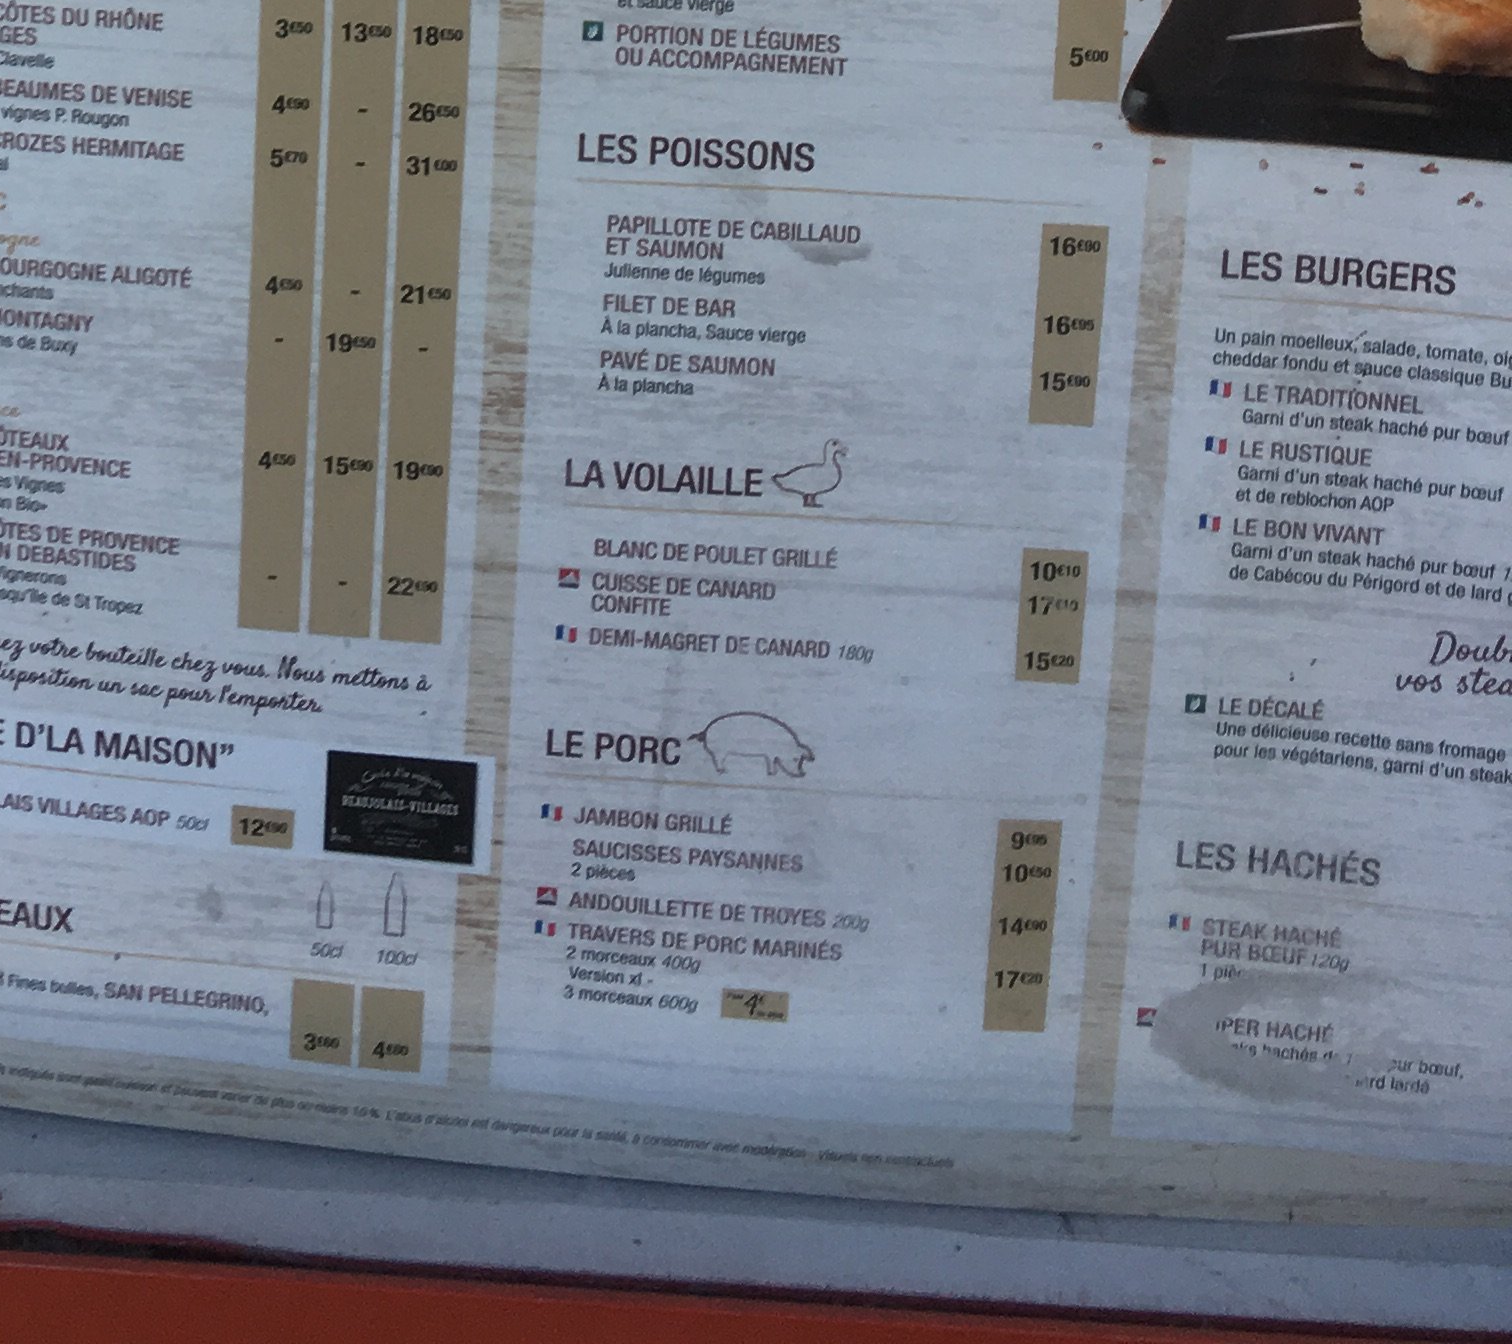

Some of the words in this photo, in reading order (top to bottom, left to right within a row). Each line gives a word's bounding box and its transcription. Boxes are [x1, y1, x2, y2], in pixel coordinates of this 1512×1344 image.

[617, 25, 704, 46] PORTION
[710, 28, 736, 48] DE
[744, 29, 841, 52] LÉGUMES
[615, 46, 644, 67] OU
[649, 49, 848, 76] ACCOMPAGNEMENT
[577, 133, 638, 165] LES
[650, 137, 815, 172] POISSONS
[1221, 250, 1283, 282] LES
[1294, 255, 1457, 295] BURGERS
[1240, 441, 1264, 460] LE
[1270, 443, 1373, 467] RUSTIQUE
[565, 459, 603, 488] LA
[613, 461, 764, 496] VOLAILLE
[594, 540, 658, 561] BLANC
[663, 543, 689, 562] DE
[694, 544, 767, 566] POULET
[772, 547, 838, 569] GRILLÉ
[28, 639, 81, 660] votre
[85, 634, 167, 668] bouteille
[172, 653, 218, 679] chez
[222, 661, 269, 677] vous.
[278, 656, 325, 684] Nous
[332, 666, 410, 691] mettons
[589, 627, 720, 653] DEMI-MAGRET
[726, 634, 751, 655] DE
[755, 636, 830, 659] CANARD
[837, 643, 874, 664] 180g
[1219, 697, 1243, 716] LE
[1248, 695, 1324, 720] DÉCALÉ
[545, 730, 584, 758] LE
[594, 734, 681, 765] PORC
[572, 839, 683, 865] SAUCISSES
[688, 847, 803, 873] PAYSANNES
[1176, 840, 1236, 872] LES
[1248, 842, 1382, 888] HACHÉS
